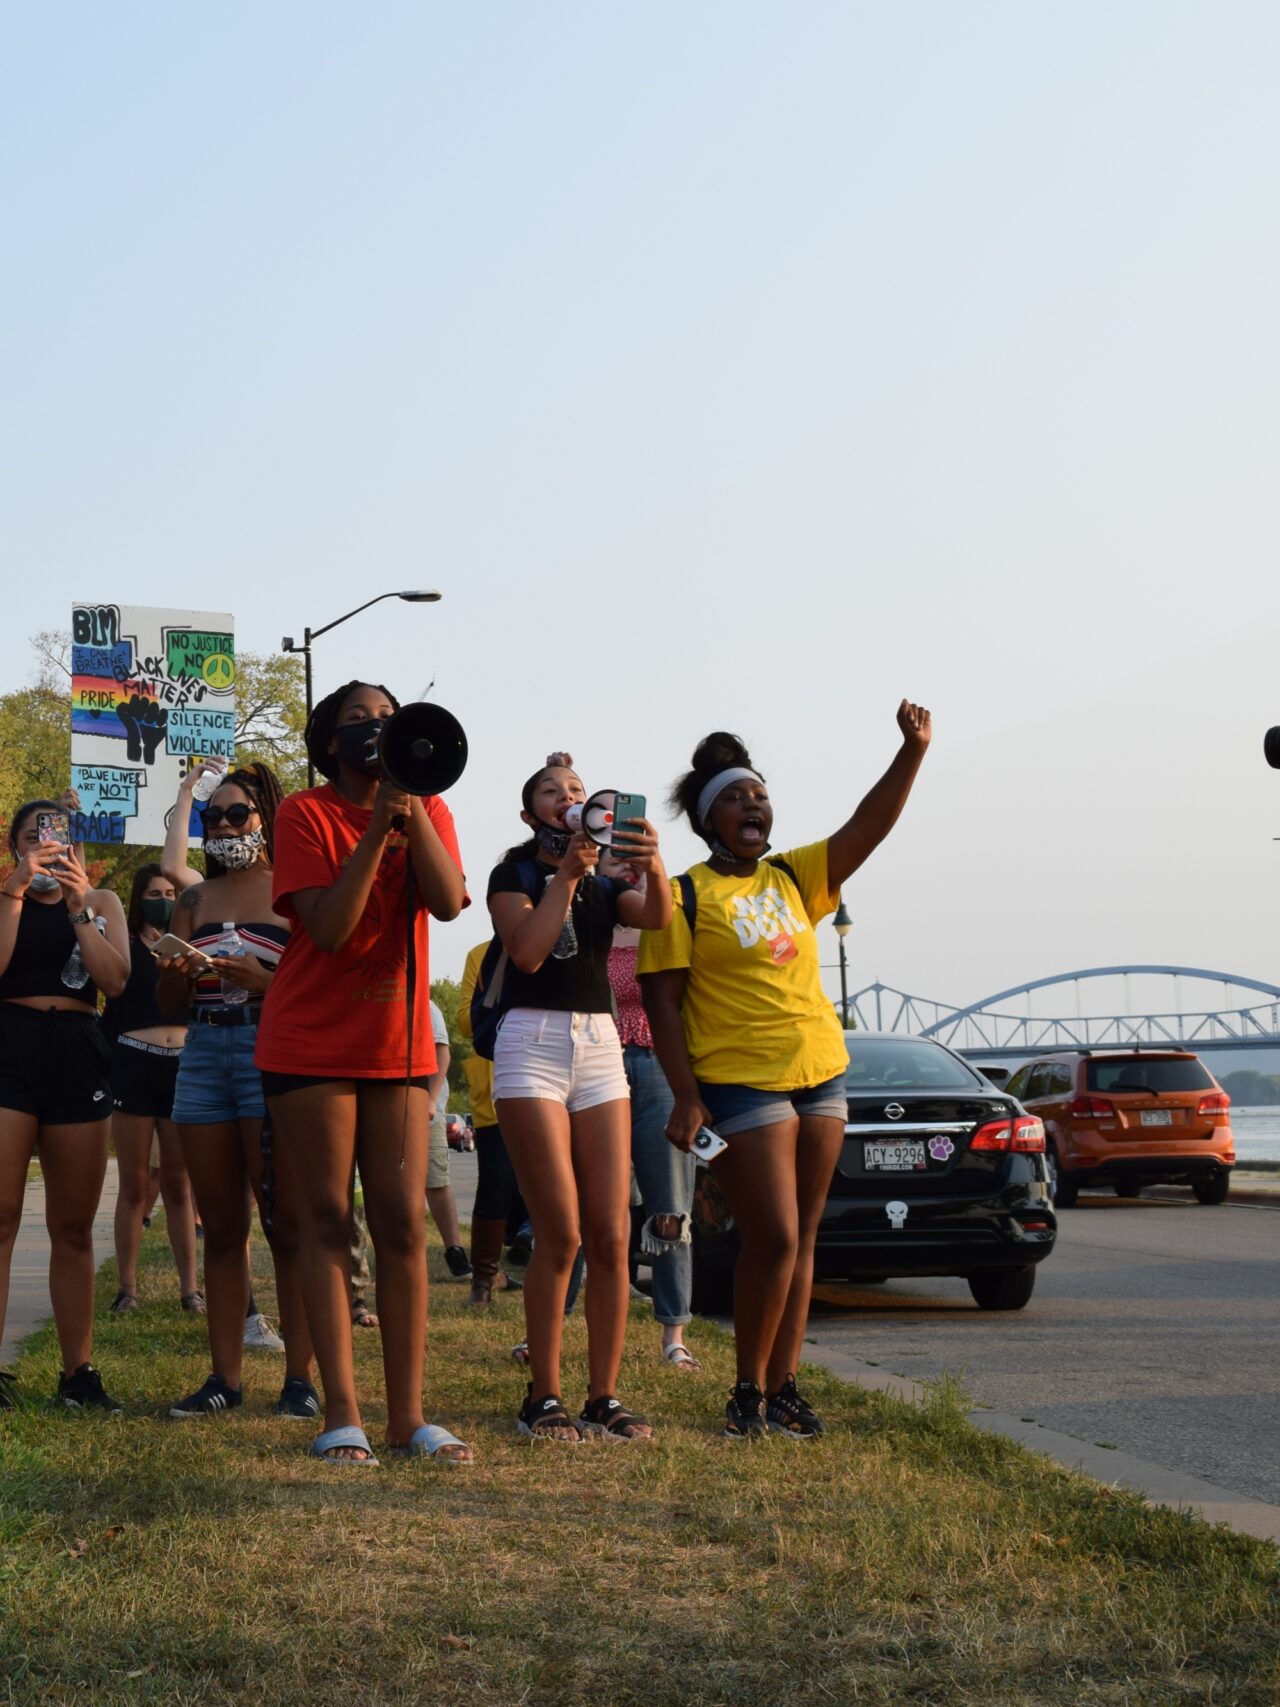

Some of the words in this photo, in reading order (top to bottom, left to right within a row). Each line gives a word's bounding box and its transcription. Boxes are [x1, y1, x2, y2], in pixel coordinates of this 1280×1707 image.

[72, 607, 118, 647] BLM
[75, 649, 85, 659] I
[171, 634, 190, 650] NO
[192, 636, 234, 654] JUSTICE
[75, 654, 125, 672] BREATHE
[112, 655, 164, 684] BLACK
[184, 652, 205, 670] NO
[80, 689, 116, 709] PRIDE
[123, 677, 189, 712] MATTER
[170, 711, 233, 730] SILENCE
[190, 728, 202, 736] IS
[169, 735, 234, 758] VIOLENCE
[77, 782, 96, 792] ARE
[99, 783, 132, 798] NOT
[75, 809, 123, 841] RACE
[732, 914, 781, 949] DO
